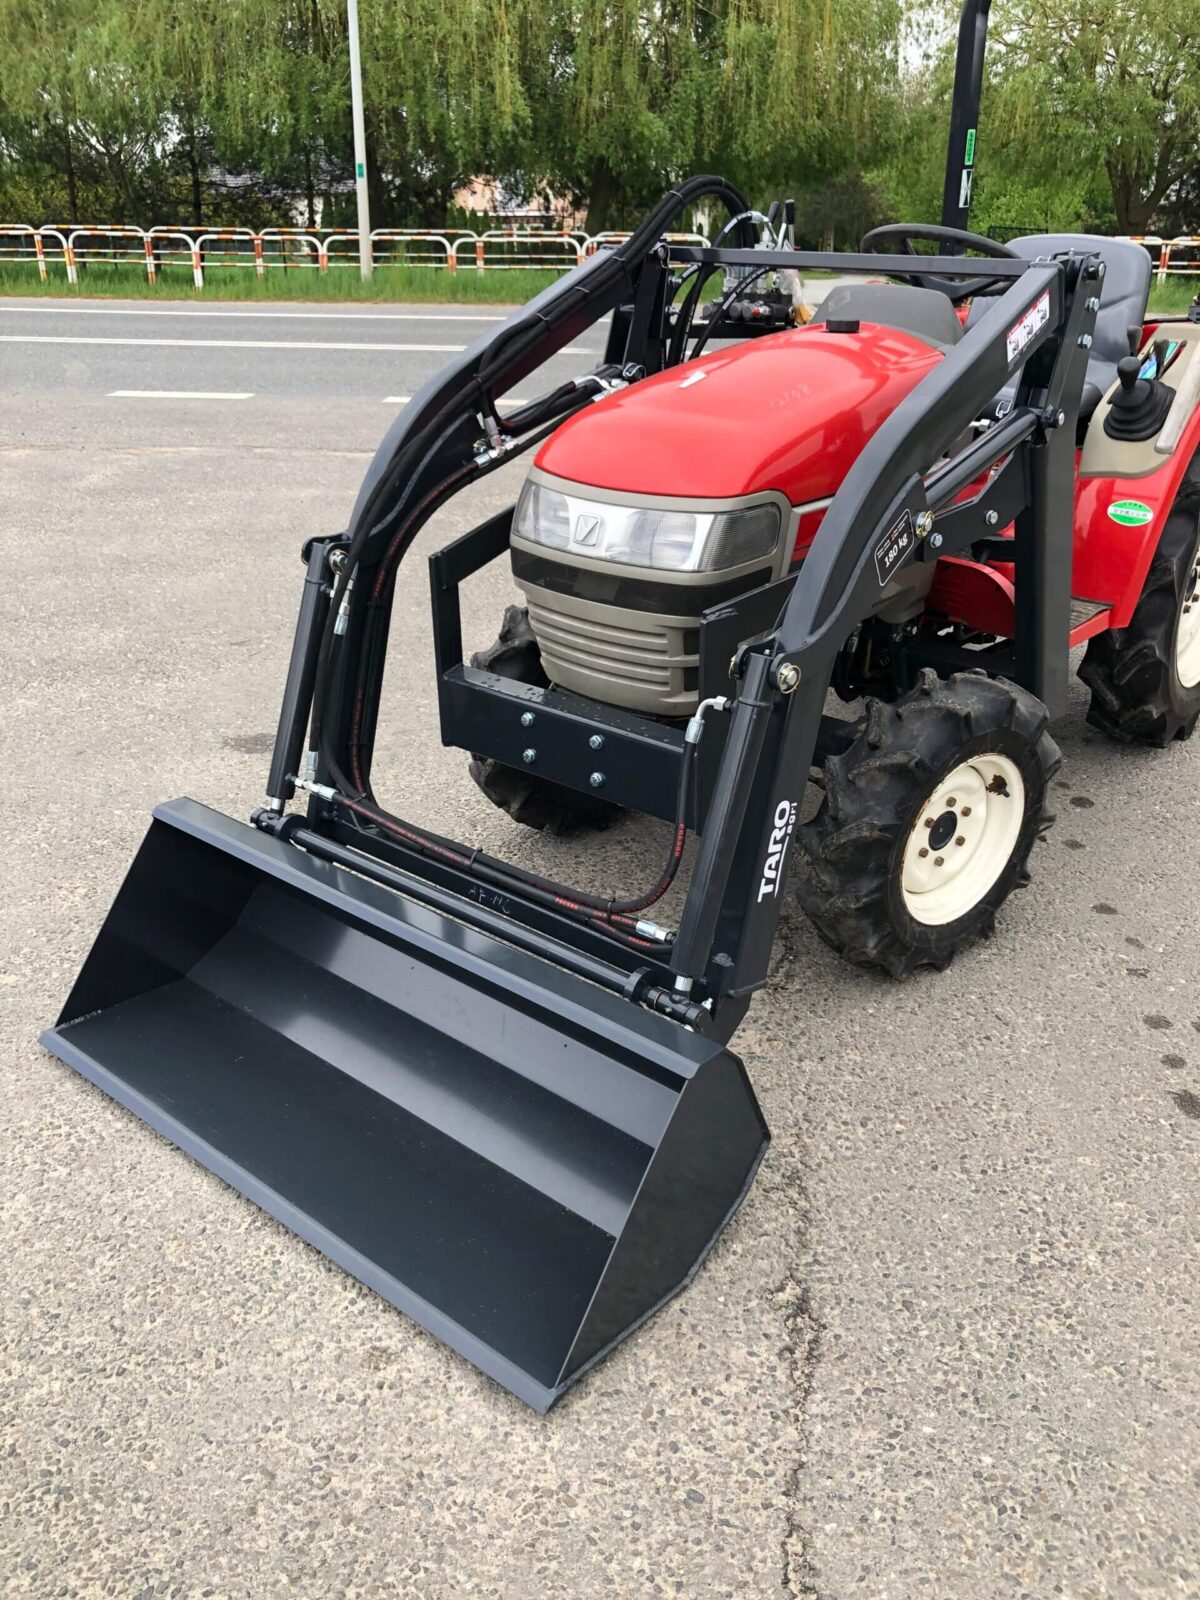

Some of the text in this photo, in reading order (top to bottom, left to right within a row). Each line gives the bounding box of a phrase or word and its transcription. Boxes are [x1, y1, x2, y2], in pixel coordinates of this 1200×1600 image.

[884, 533, 908, 568] 180 kg
[786, 802, 798, 834] agri
[757, 799, 791, 903] TARO
